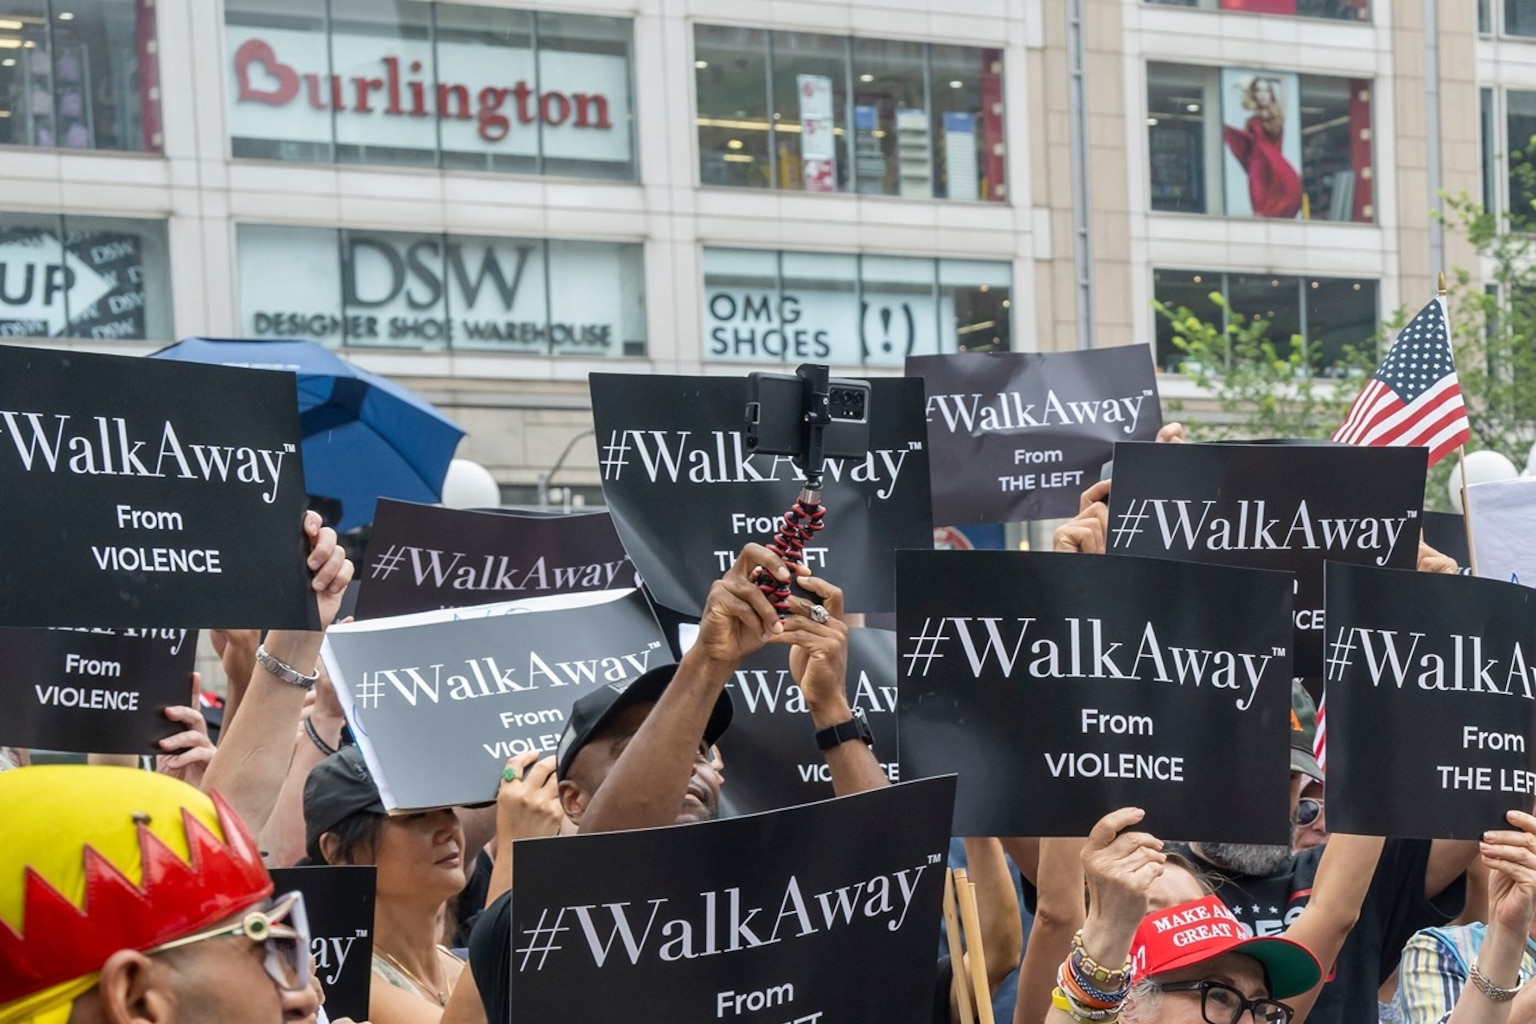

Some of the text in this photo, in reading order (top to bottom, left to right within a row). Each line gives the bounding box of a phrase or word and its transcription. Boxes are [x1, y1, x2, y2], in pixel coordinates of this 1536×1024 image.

[343, 235, 536, 313] DSW
[709, 292, 802, 324] OMG
[253, 311, 612, 348] DESIGNER SHOE WAREHOUSE
[710, 326, 832, 358] SHOES
[0, 410, 297, 504] WalkAway™
[1014, 448, 1063, 466] From
[998, 469, 1085, 492] THE LEFT
[115, 504, 184, 531] From
[91, 545, 223, 574] VIOLENCE
[65, 653, 122, 677] From
[34, 684, 140, 712] VIOLENCE
[499, 705, 564, 730] From
[1081, 708, 1154, 736] From
[1462, 725, 1526, 753] From
[1044, 751, 1185, 782] VIOLENCE
[1437, 765, 1493, 791] THE
[1153, 906, 1212, 935] MAKE
[1172, 922, 1233, 948] GREAT
[716, 980, 795, 1019] From
